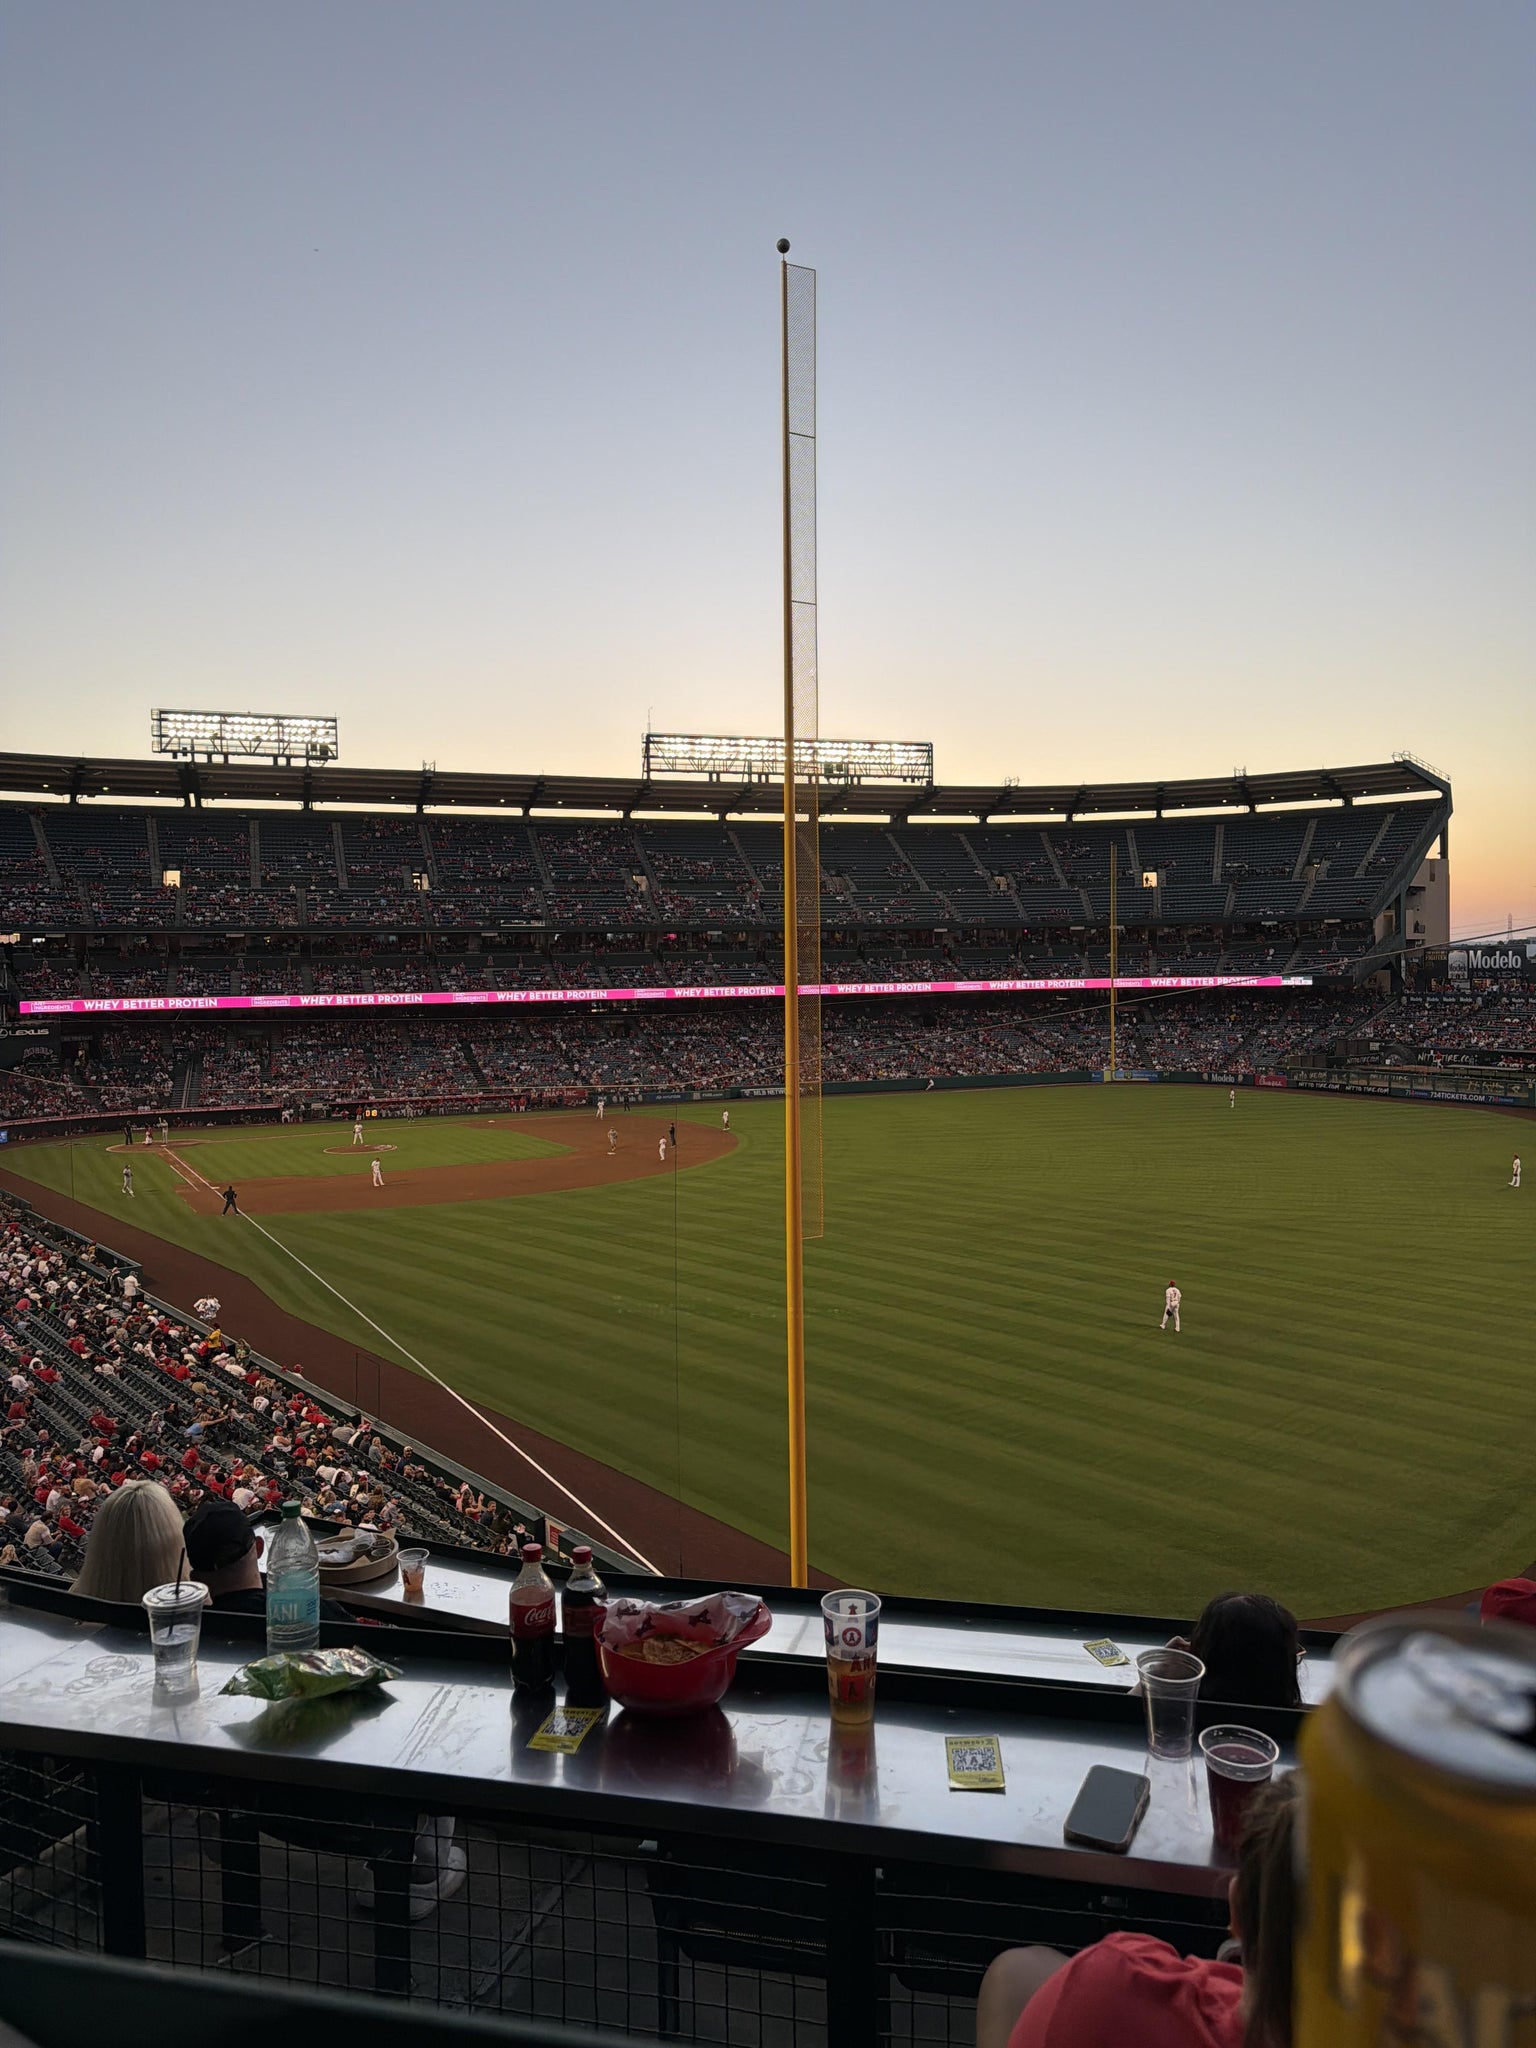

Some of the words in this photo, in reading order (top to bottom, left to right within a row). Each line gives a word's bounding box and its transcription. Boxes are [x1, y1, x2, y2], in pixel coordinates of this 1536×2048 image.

[1469, 950, 1522, 969] Modelo
[989, 981, 1014, 989] WHEY
[1016, 981, 1045, 989] BETTER
[1048, 980, 1085, 988] PROTEIN
[1150, 978, 1177, 986] WHEY
[1180, 978, 1214, 986] BETTER
[674, 988, 702, 997] WHEY
[704, 988, 736, 996] BETTER
[738, 986, 775, 995] PROTEIN
[837, 984, 863, 993] WHEY
[865, 984, 894, 992] BETTER
[897, 983, 931, 991] PROTEIN
[300, 996, 332, 1005] WHEY
[336, 996, 374, 1004] BETTER
[378, 995, 422, 1003] PROTEIN
[497, 992, 526, 1001] WHEY
[529, 991, 563, 1000] BETTER
[567, 991, 607, 999] PROTEIN
[84, 999, 118, 1010] WHEY
[123, 999, 165, 1009] BETTER
[168, 998, 217, 1008] PROTEIN
[9, 1028, 49, 1036] LEXUS
[1212, 1073, 1235, 1083] Modelo
[1431, 1091, 1485, 1102] 714TICKETS.COM
